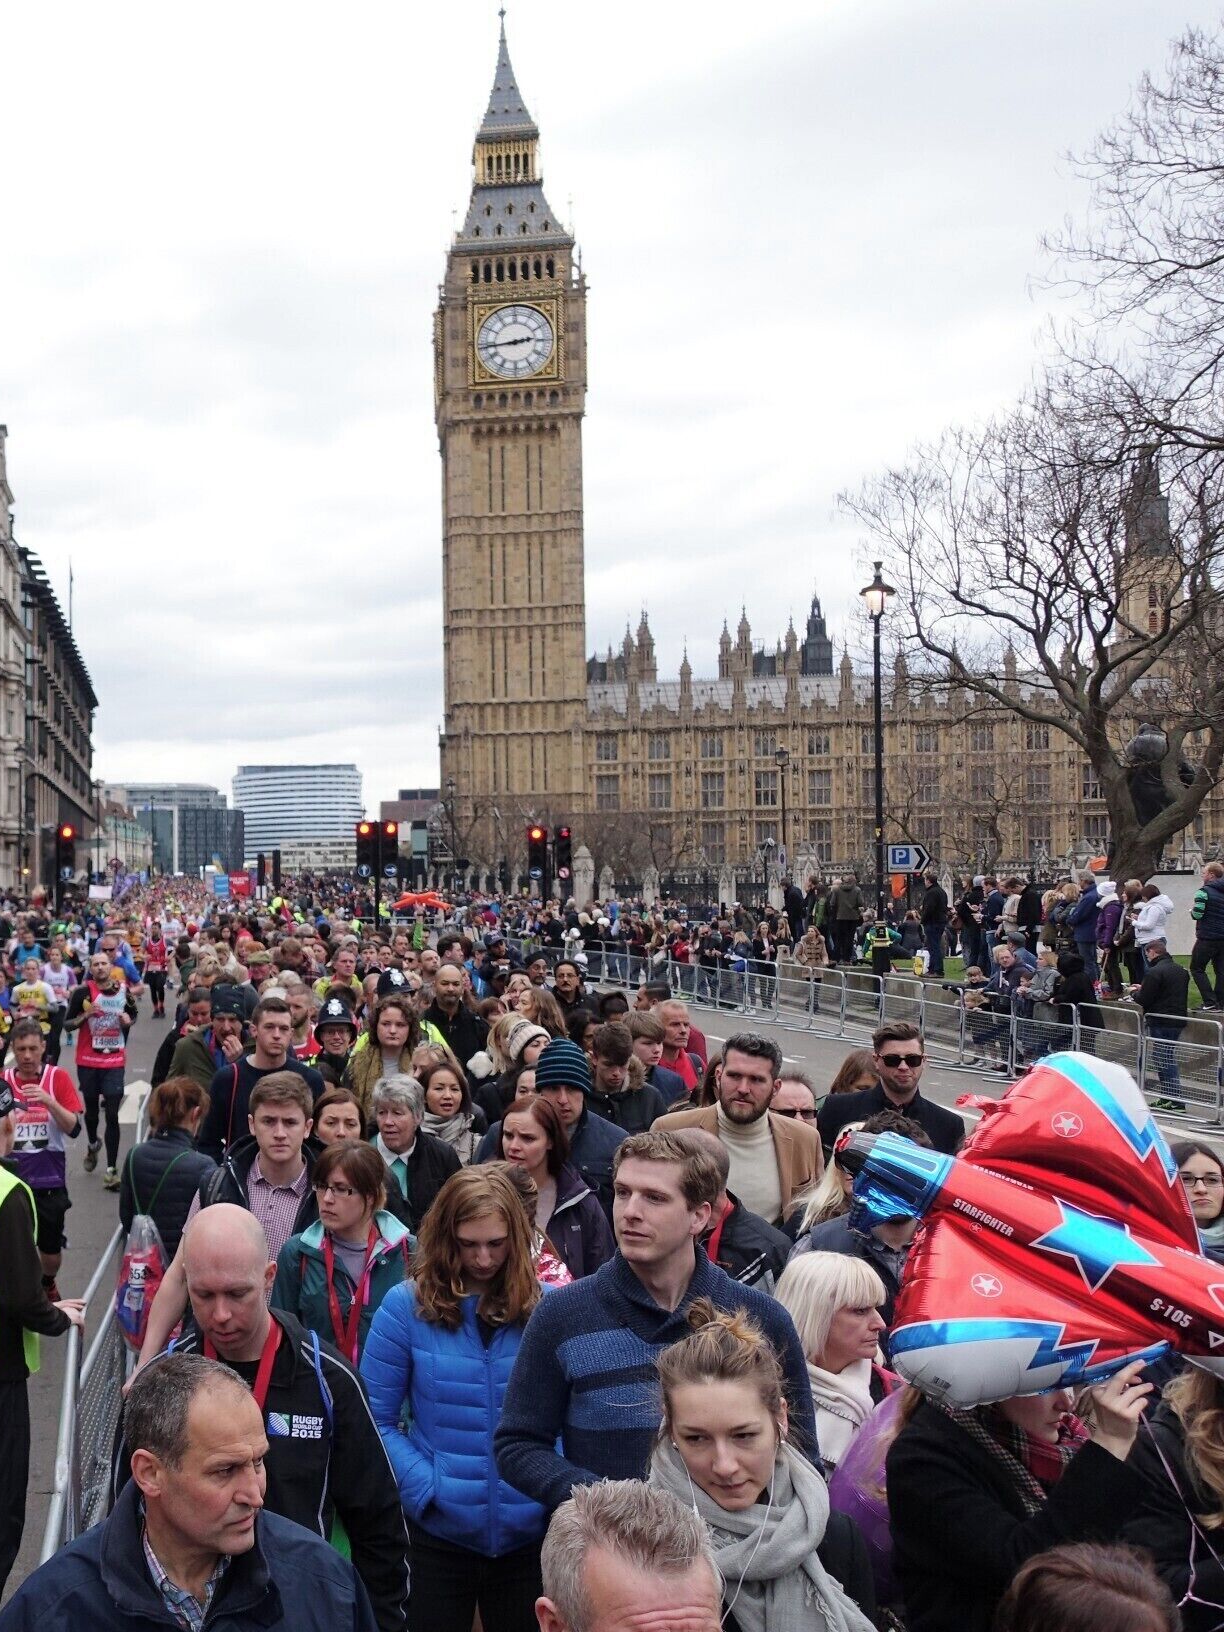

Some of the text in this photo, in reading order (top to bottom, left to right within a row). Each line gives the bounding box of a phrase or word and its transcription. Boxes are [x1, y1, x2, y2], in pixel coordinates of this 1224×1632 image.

[896, 849, 907, 864] P
[952, 1198, 1015, 1237] STARFIGHTER
[1150, 1298, 1193, 1328] S-105
[293, 1415, 324, 1425] RUGBY
[292, 1429, 322, 1438] 2015
